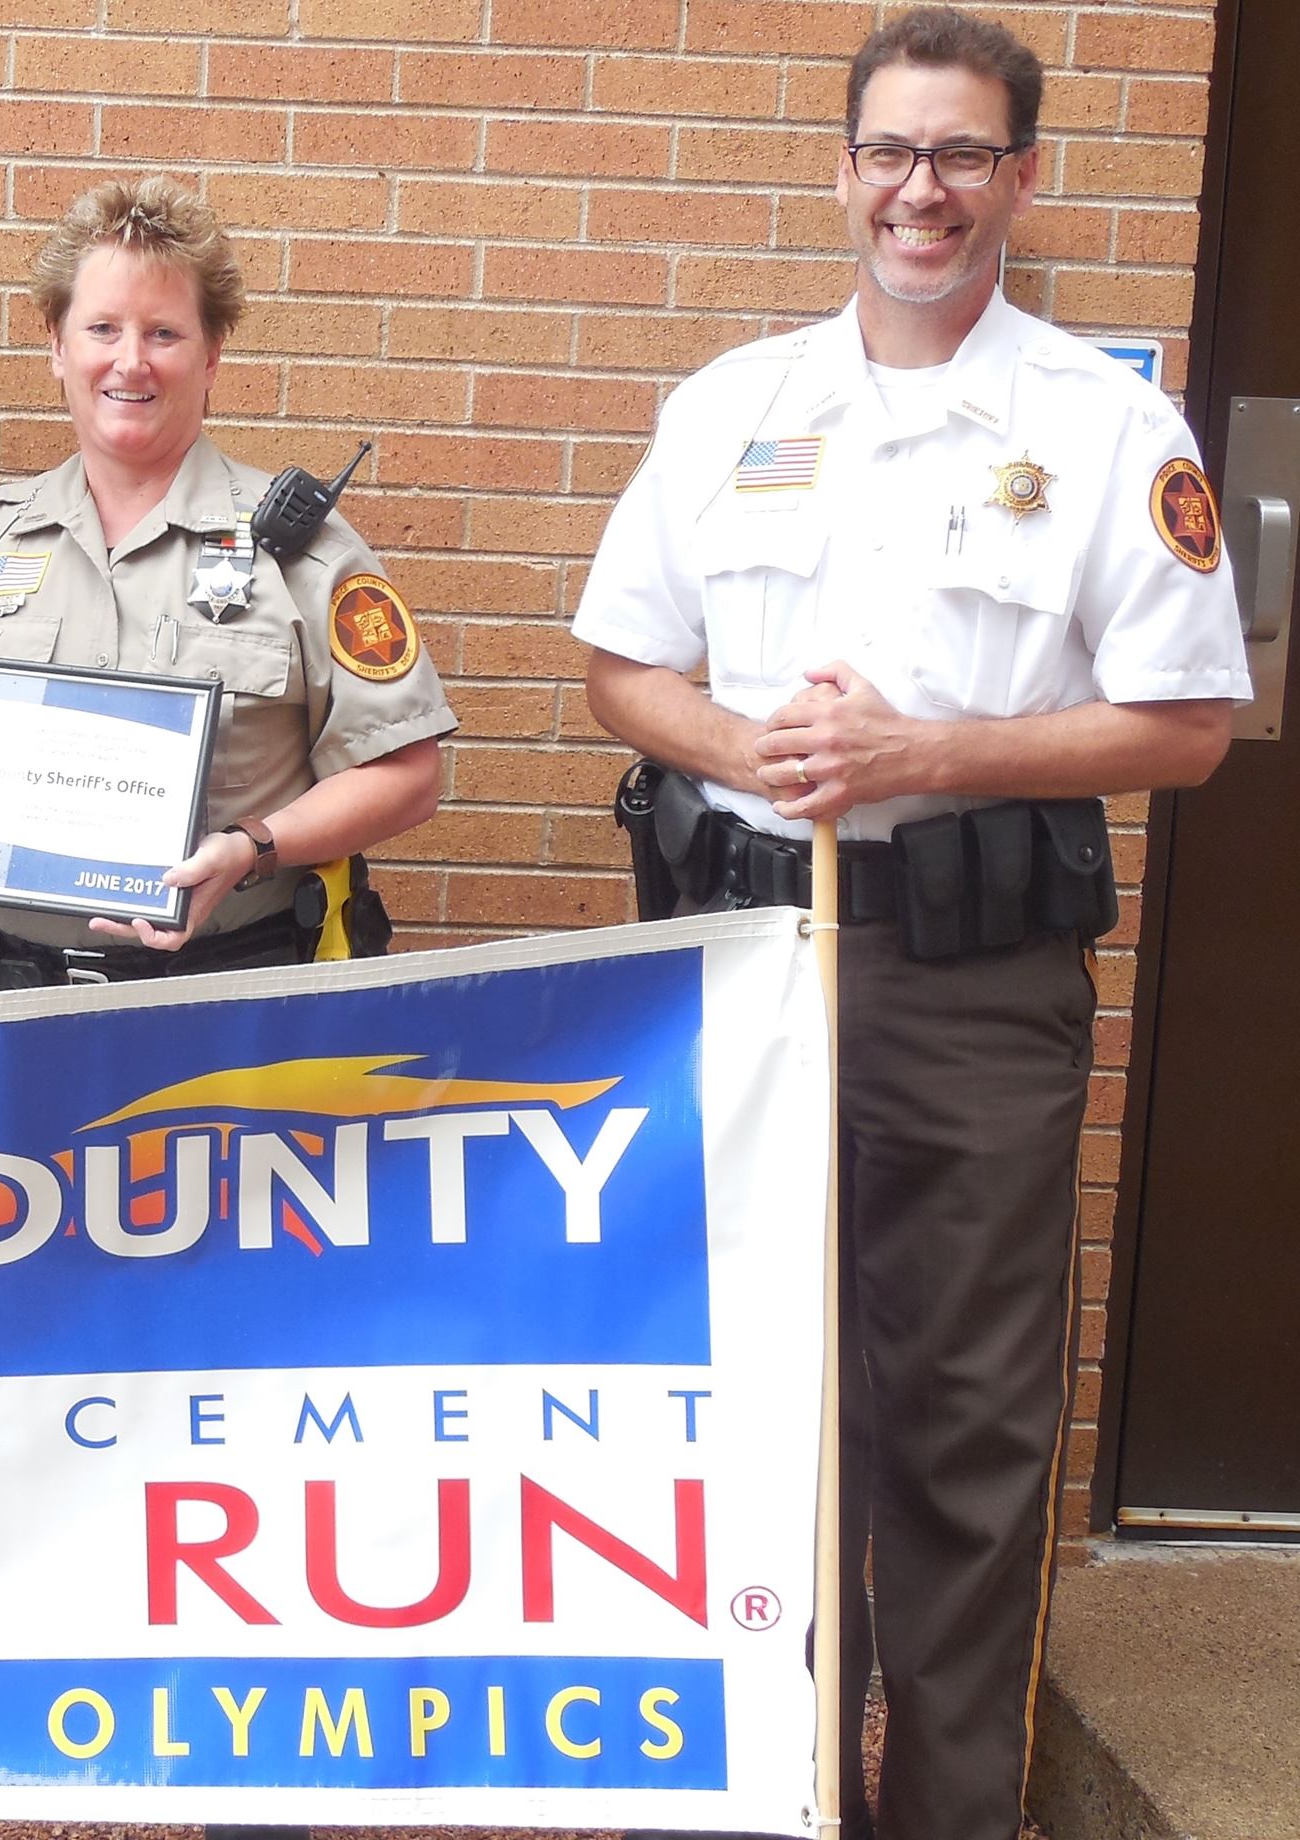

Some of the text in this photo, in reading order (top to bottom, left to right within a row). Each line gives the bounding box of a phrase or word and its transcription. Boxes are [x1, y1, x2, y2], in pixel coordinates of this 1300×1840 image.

[1160, 463, 1177, 482] PRICE
[356, 577, 387, 590] COUNTY
[46, 771, 112, 792] Sheriff's
[116, 779, 167, 798] Office
[74, 870, 166, 897] JUNE 2017
[144, 1472, 709, 1632] RUN
[46, 1685, 686, 1761] OLYMPICS
